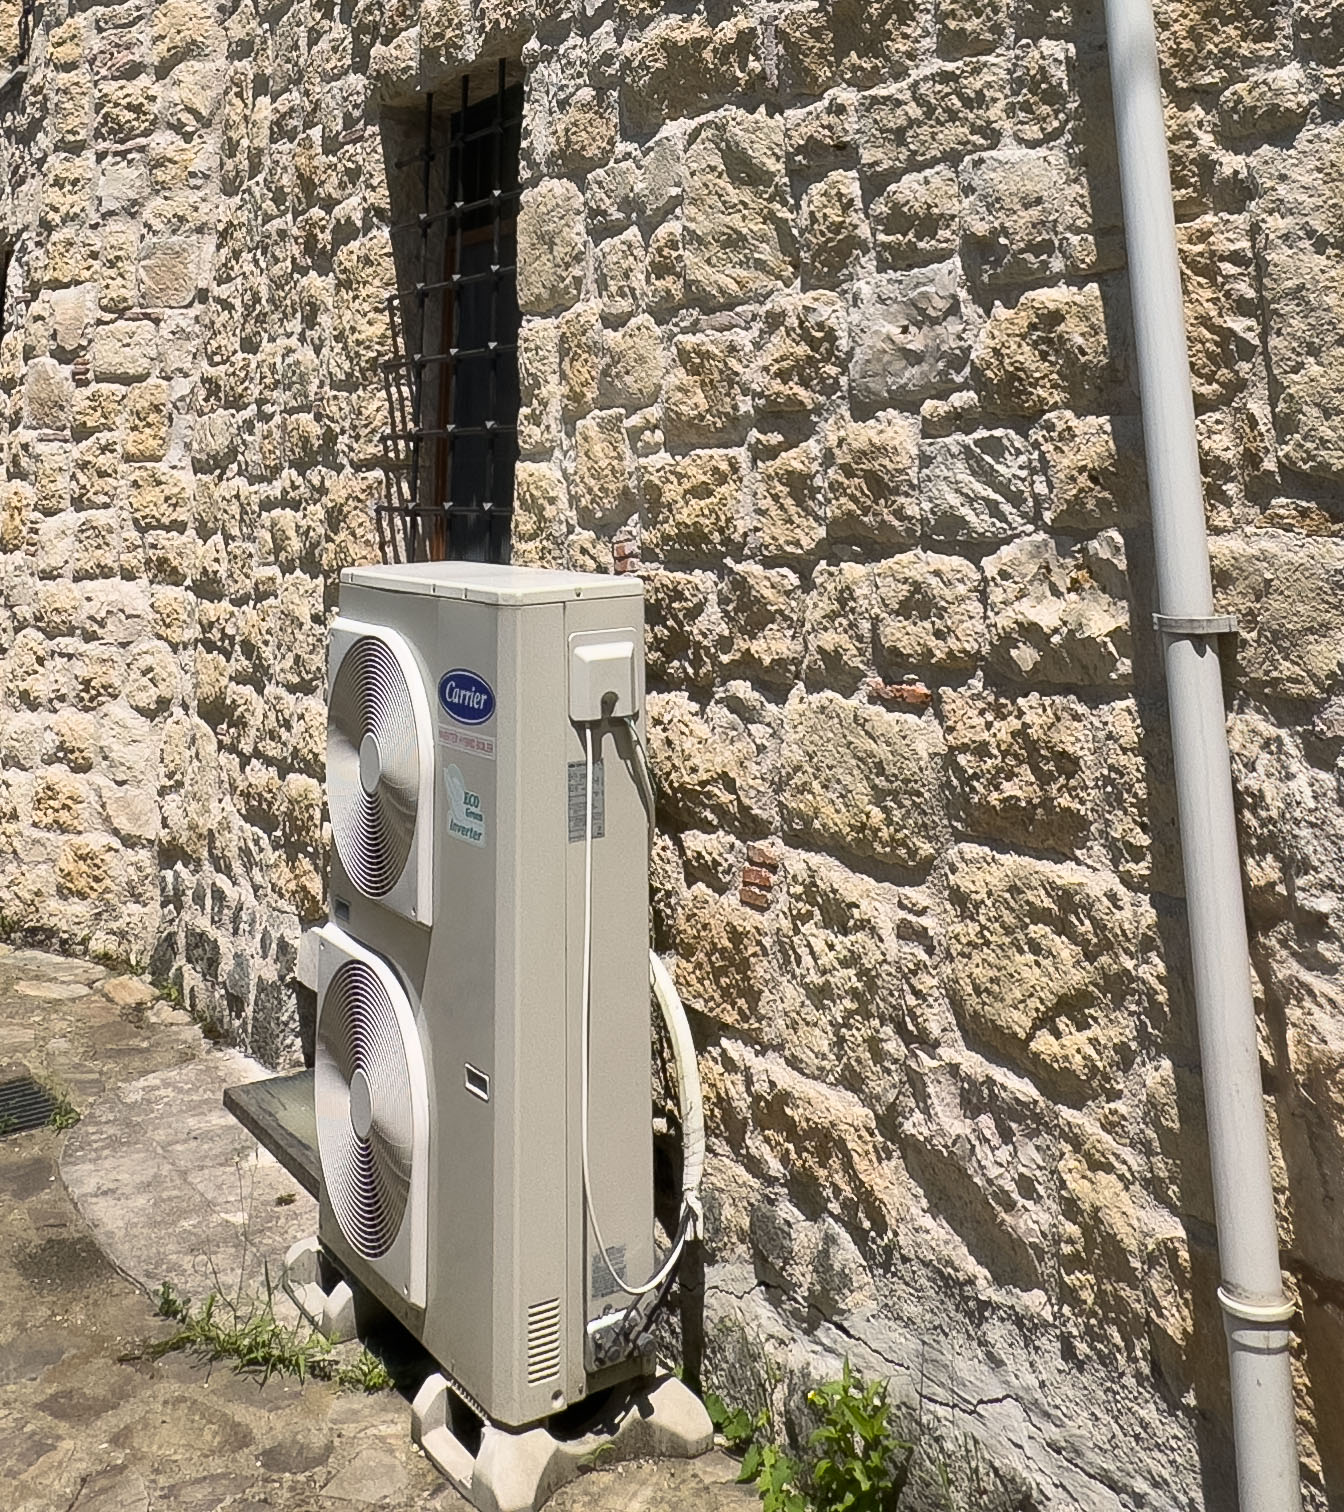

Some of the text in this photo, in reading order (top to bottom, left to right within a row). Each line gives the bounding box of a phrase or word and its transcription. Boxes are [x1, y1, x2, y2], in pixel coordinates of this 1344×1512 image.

[446, 680, 487, 709] Carrier
[463, 791, 480, 808] ECO
[450, 818, 482, 841] Inverter
